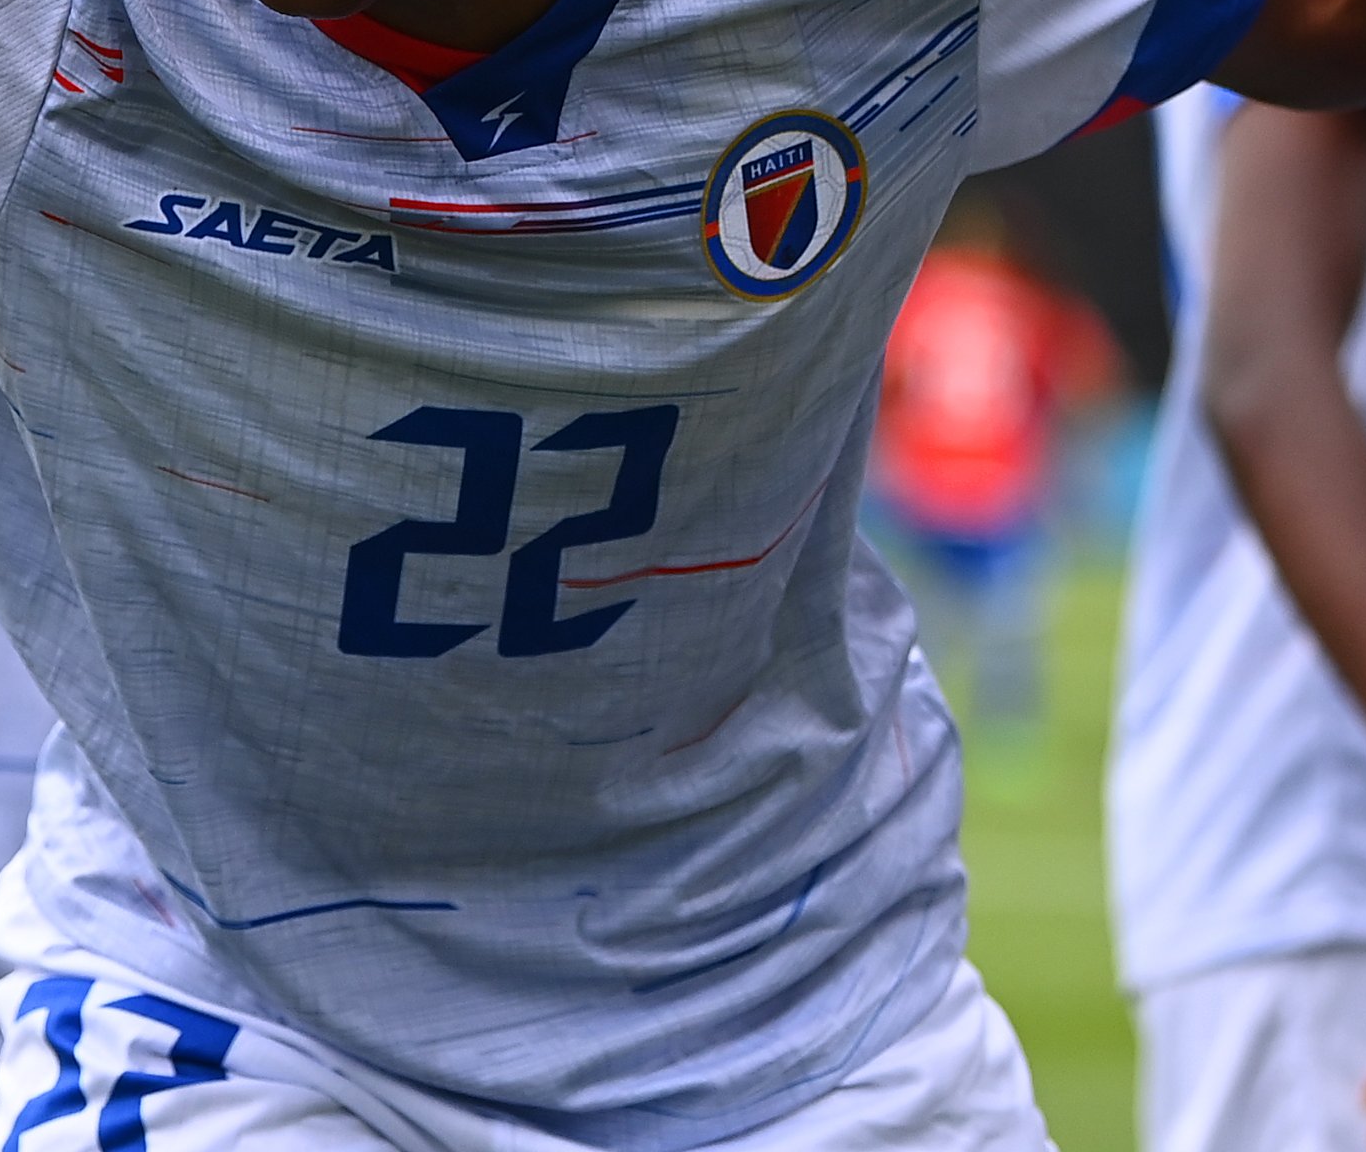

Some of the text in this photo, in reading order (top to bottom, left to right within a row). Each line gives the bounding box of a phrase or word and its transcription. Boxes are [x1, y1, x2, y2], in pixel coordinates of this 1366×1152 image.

[750, 147, 804, 179] HAITI
[125, 193, 397, 273] SAETA
[338, 405, 680, 659] 22
